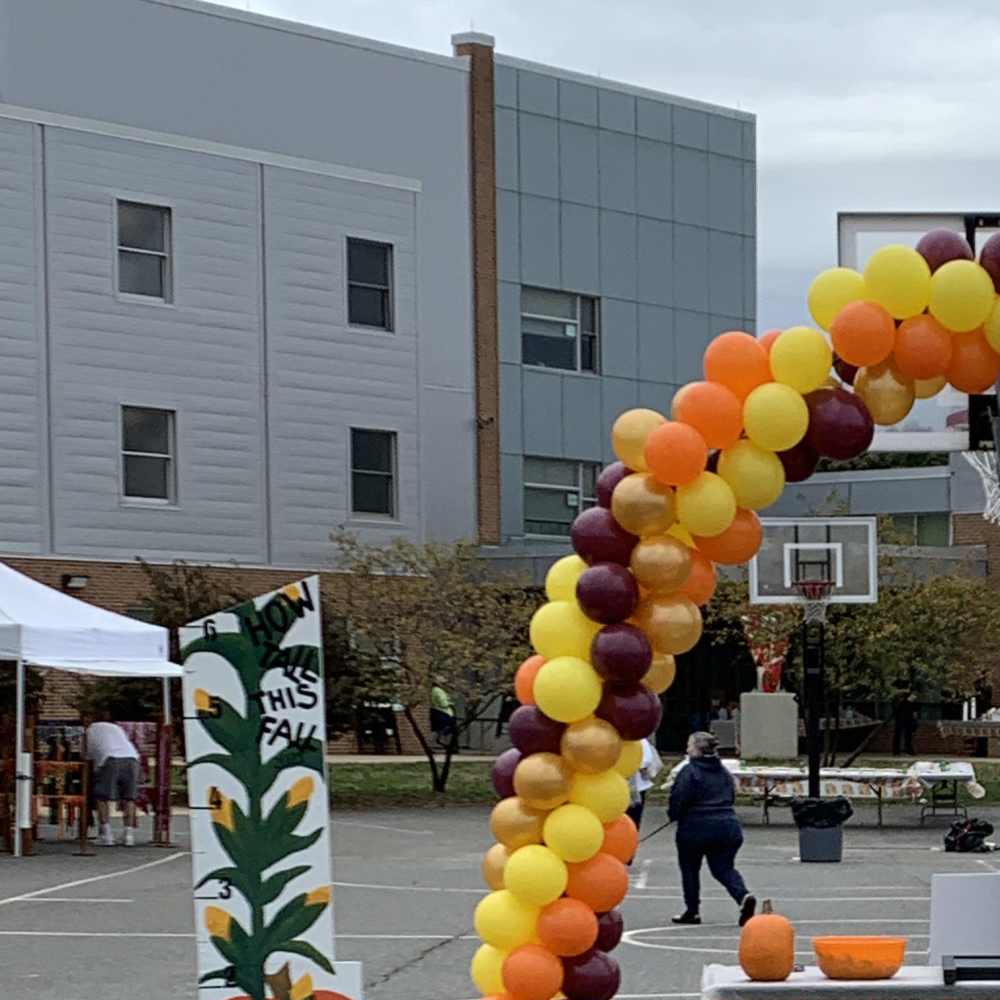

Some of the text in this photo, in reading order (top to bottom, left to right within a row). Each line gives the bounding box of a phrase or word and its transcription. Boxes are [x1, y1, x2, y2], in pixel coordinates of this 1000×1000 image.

[245, 581, 314, 646] HOW
[204, 620, 217, 641] 6
[249, 684, 318, 714] THIS
[257, 716, 318, 752] FALL
[219, 880, 231, 900] 3
